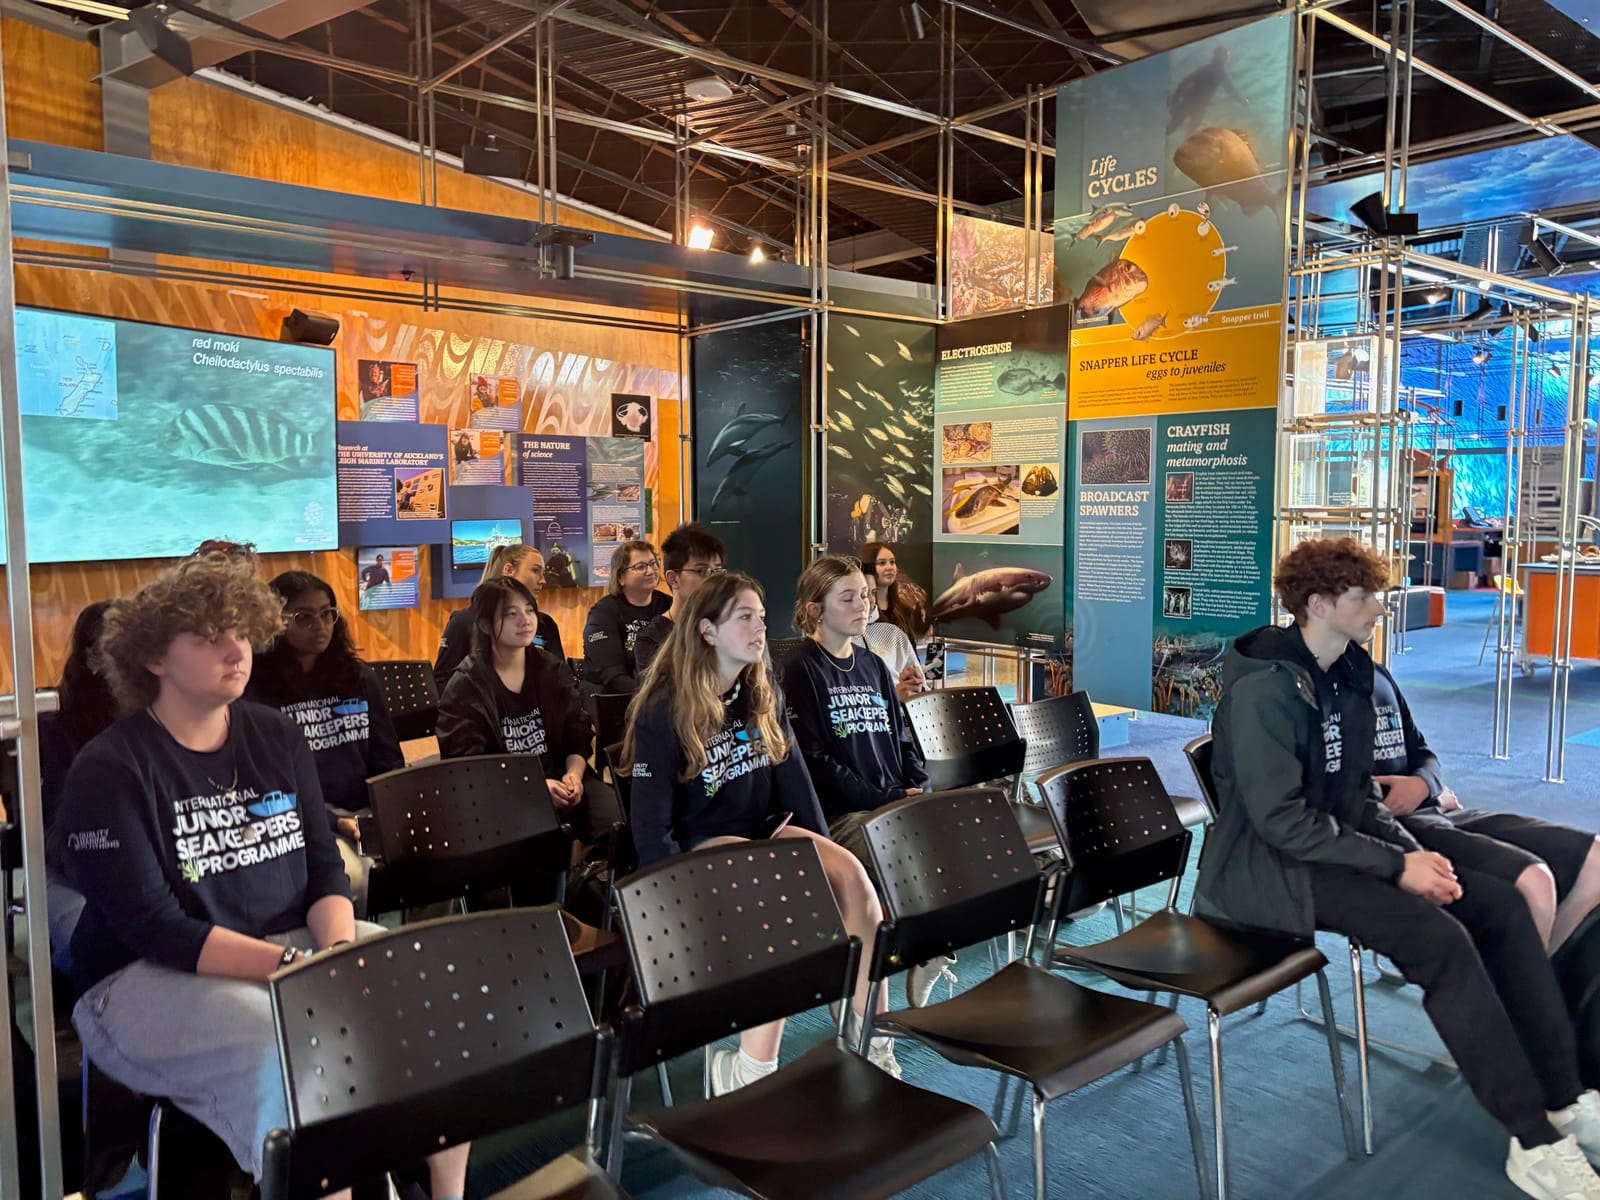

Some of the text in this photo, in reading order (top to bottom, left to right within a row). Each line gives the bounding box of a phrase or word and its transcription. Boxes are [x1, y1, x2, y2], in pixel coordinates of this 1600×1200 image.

[1088, 155, 1117, 178] Life
[1087, 167, 1157, 198] CYCLES
[1221, 309, 1270, 324] Snapper trail
[192, 337, 240, 353] red moki
[941, 341, 1012, 360] ELECTROSENSE
[192, 352, 323, 378] Cheilodactylus spectabilis
[1079, 349, 1199, 371] SNAPPER LIFE CYCLE
[1145, 360, 1226, 381] eggs to juveniles
[1167, 423, 1231, 437] CRAYFISH
[522, 441, 571, 450] THE NATURE
[1166, 438, 1228, 454] mating and
[351, 451, 393, 459] UNIVERSITY
[522, 450, 554, 459] of science
[1166, 454, 1247, 469] metamorphosis
[1079, 490, 1150, 502] BROADCAST
[1079, 505, 1140, 516] SPAWNERS
[827, 693, 872, 709] JUNIOR
[303, 713, 370, 739] AKEEPERS
[172, 805, 250, 837] JUNOR
[199, 831, 305, 877] PROGRAMME
